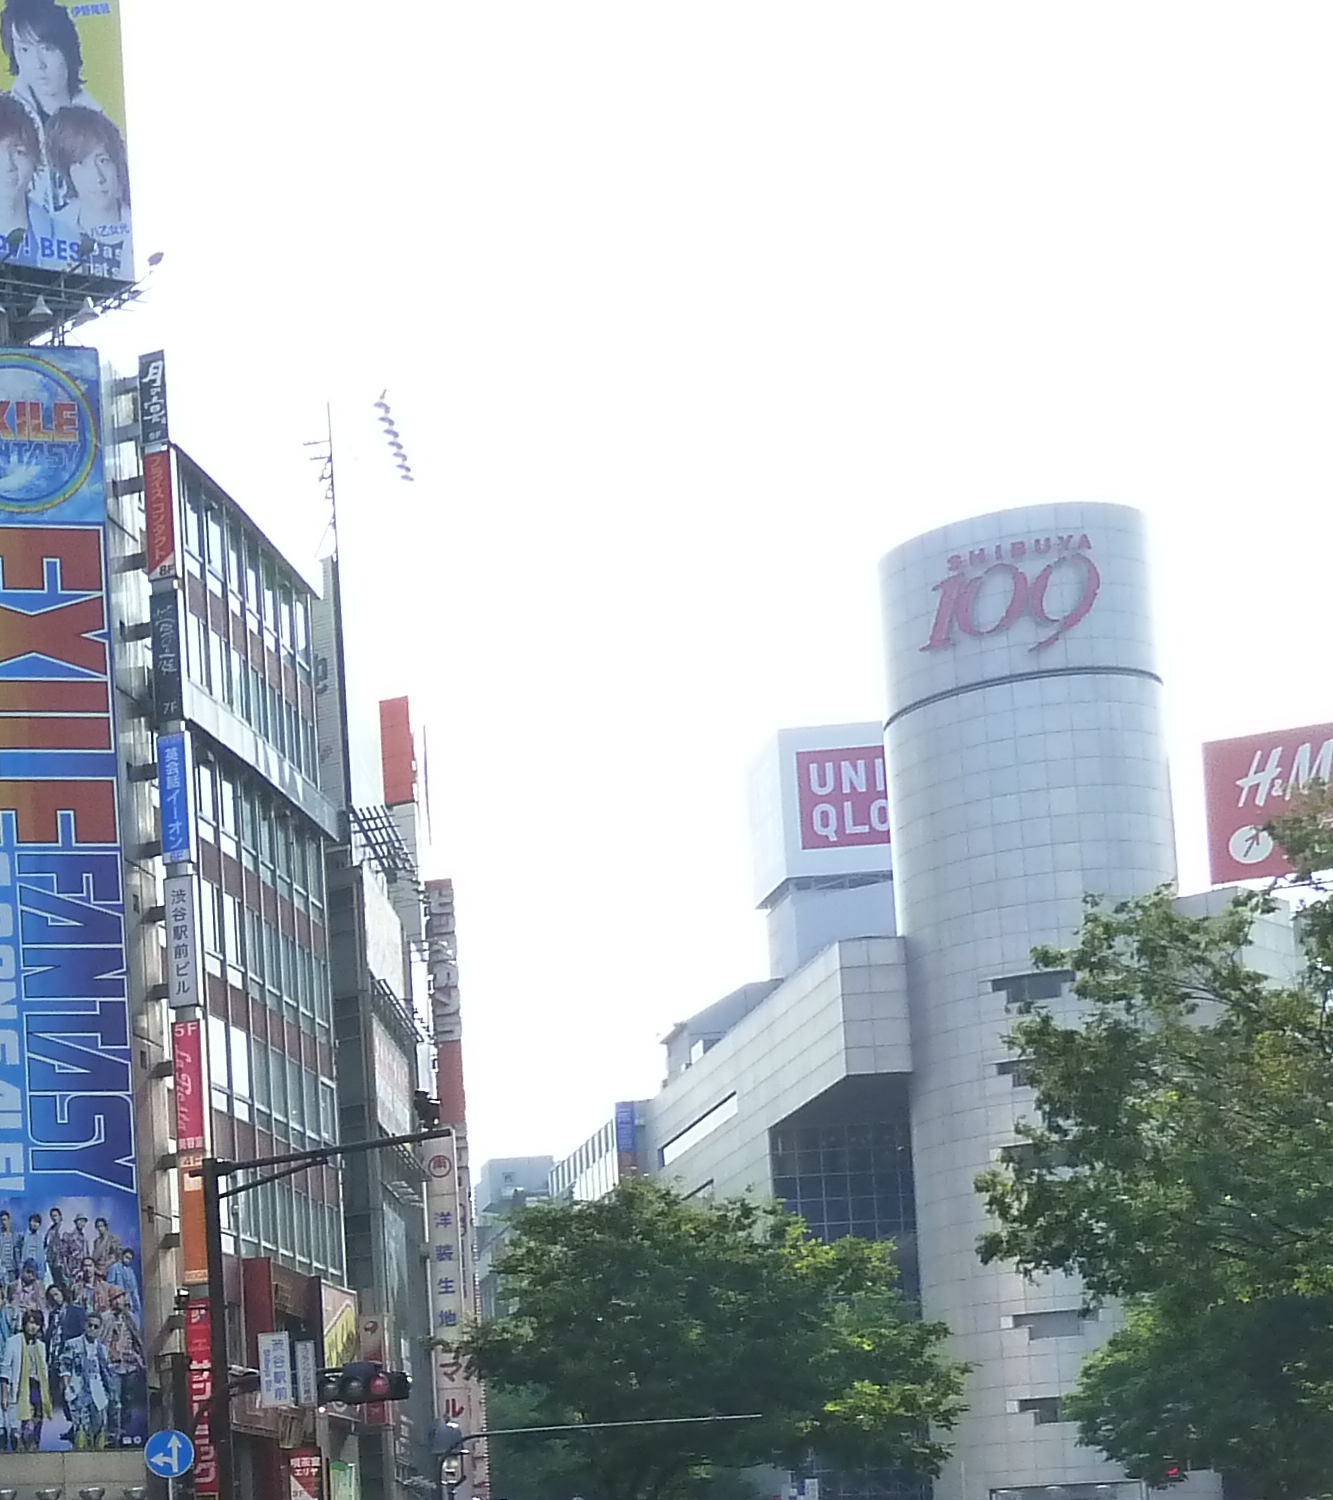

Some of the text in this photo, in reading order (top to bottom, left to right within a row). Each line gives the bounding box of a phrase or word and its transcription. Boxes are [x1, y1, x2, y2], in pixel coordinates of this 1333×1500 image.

[40, 237, 95, 263] BES
[160, 565, 173, 576] 8F
[947, 533, 1093, 572] SHIBUYA
[919, 553, 1100, 654] 109
[163, 702, 177, 714] 7F
[808, 757, 886, 796] UNI
[1235, 739, 1333, 809] H&M
[171, 889, 191, 996] 渋谷駅前ビル
[15, 852, 137, 1193] FANTASY
[174, 1024, 197, 1037] 5F
[435, 1211, 457, 1327] 洋装生地
